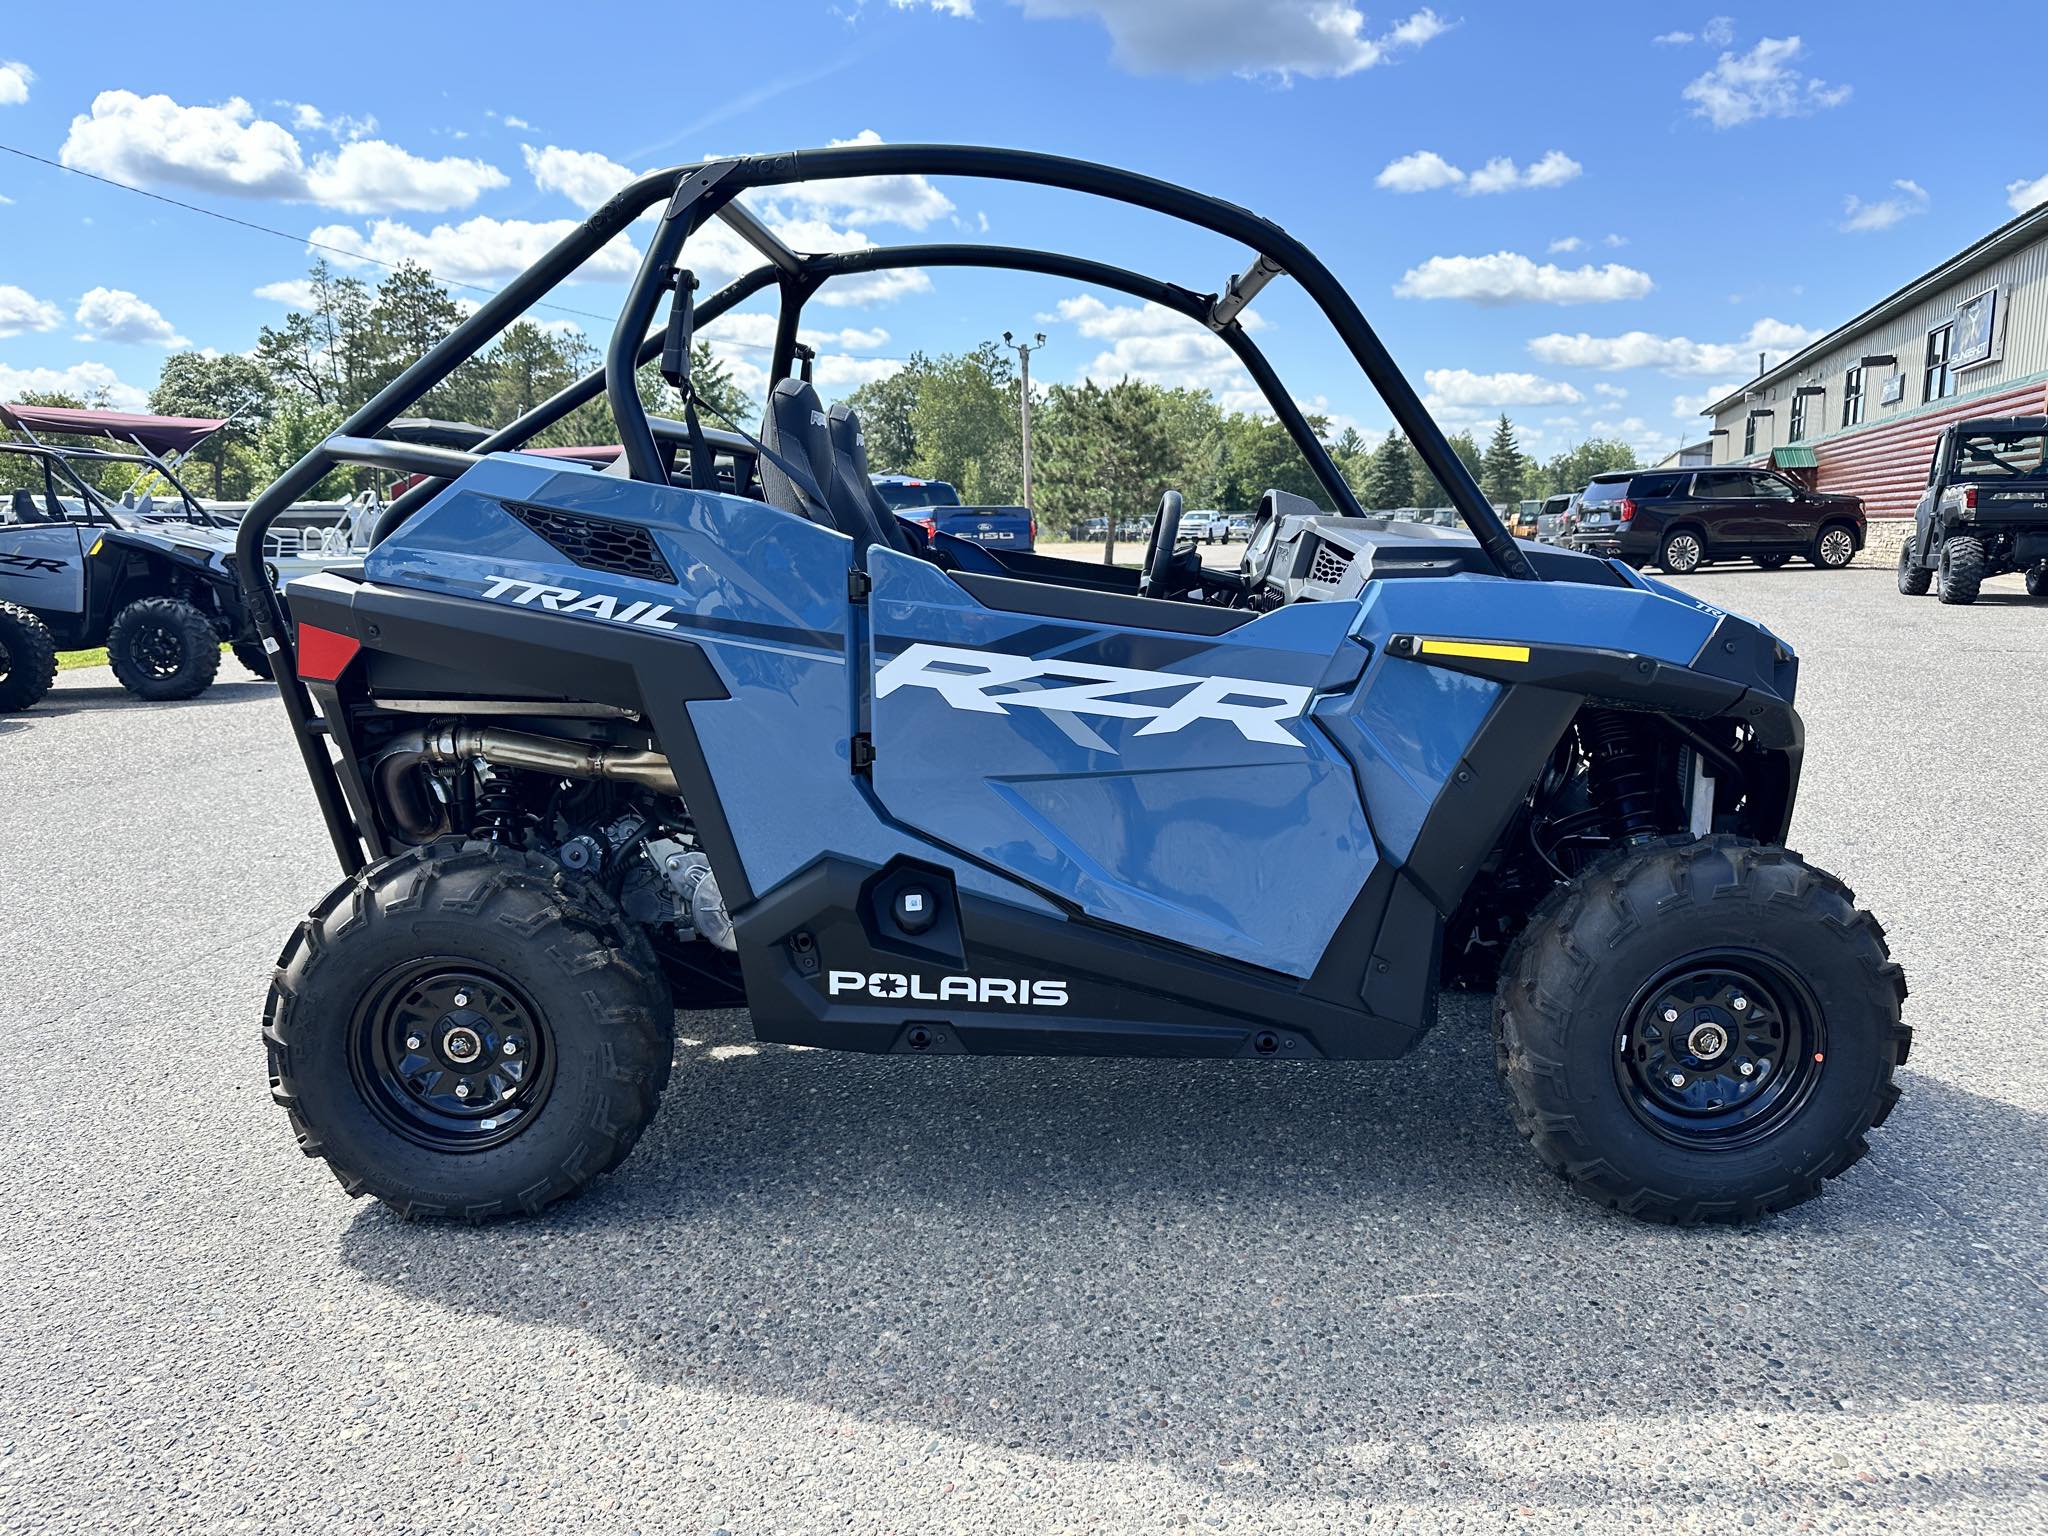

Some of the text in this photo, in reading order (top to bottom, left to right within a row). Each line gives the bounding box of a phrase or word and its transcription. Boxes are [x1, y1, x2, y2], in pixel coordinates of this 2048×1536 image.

[481, 575, 679, 630] TRAIL
[875, 643, 1314, 748] RZR
[829, 970, 1069, 1006] POLARIS
